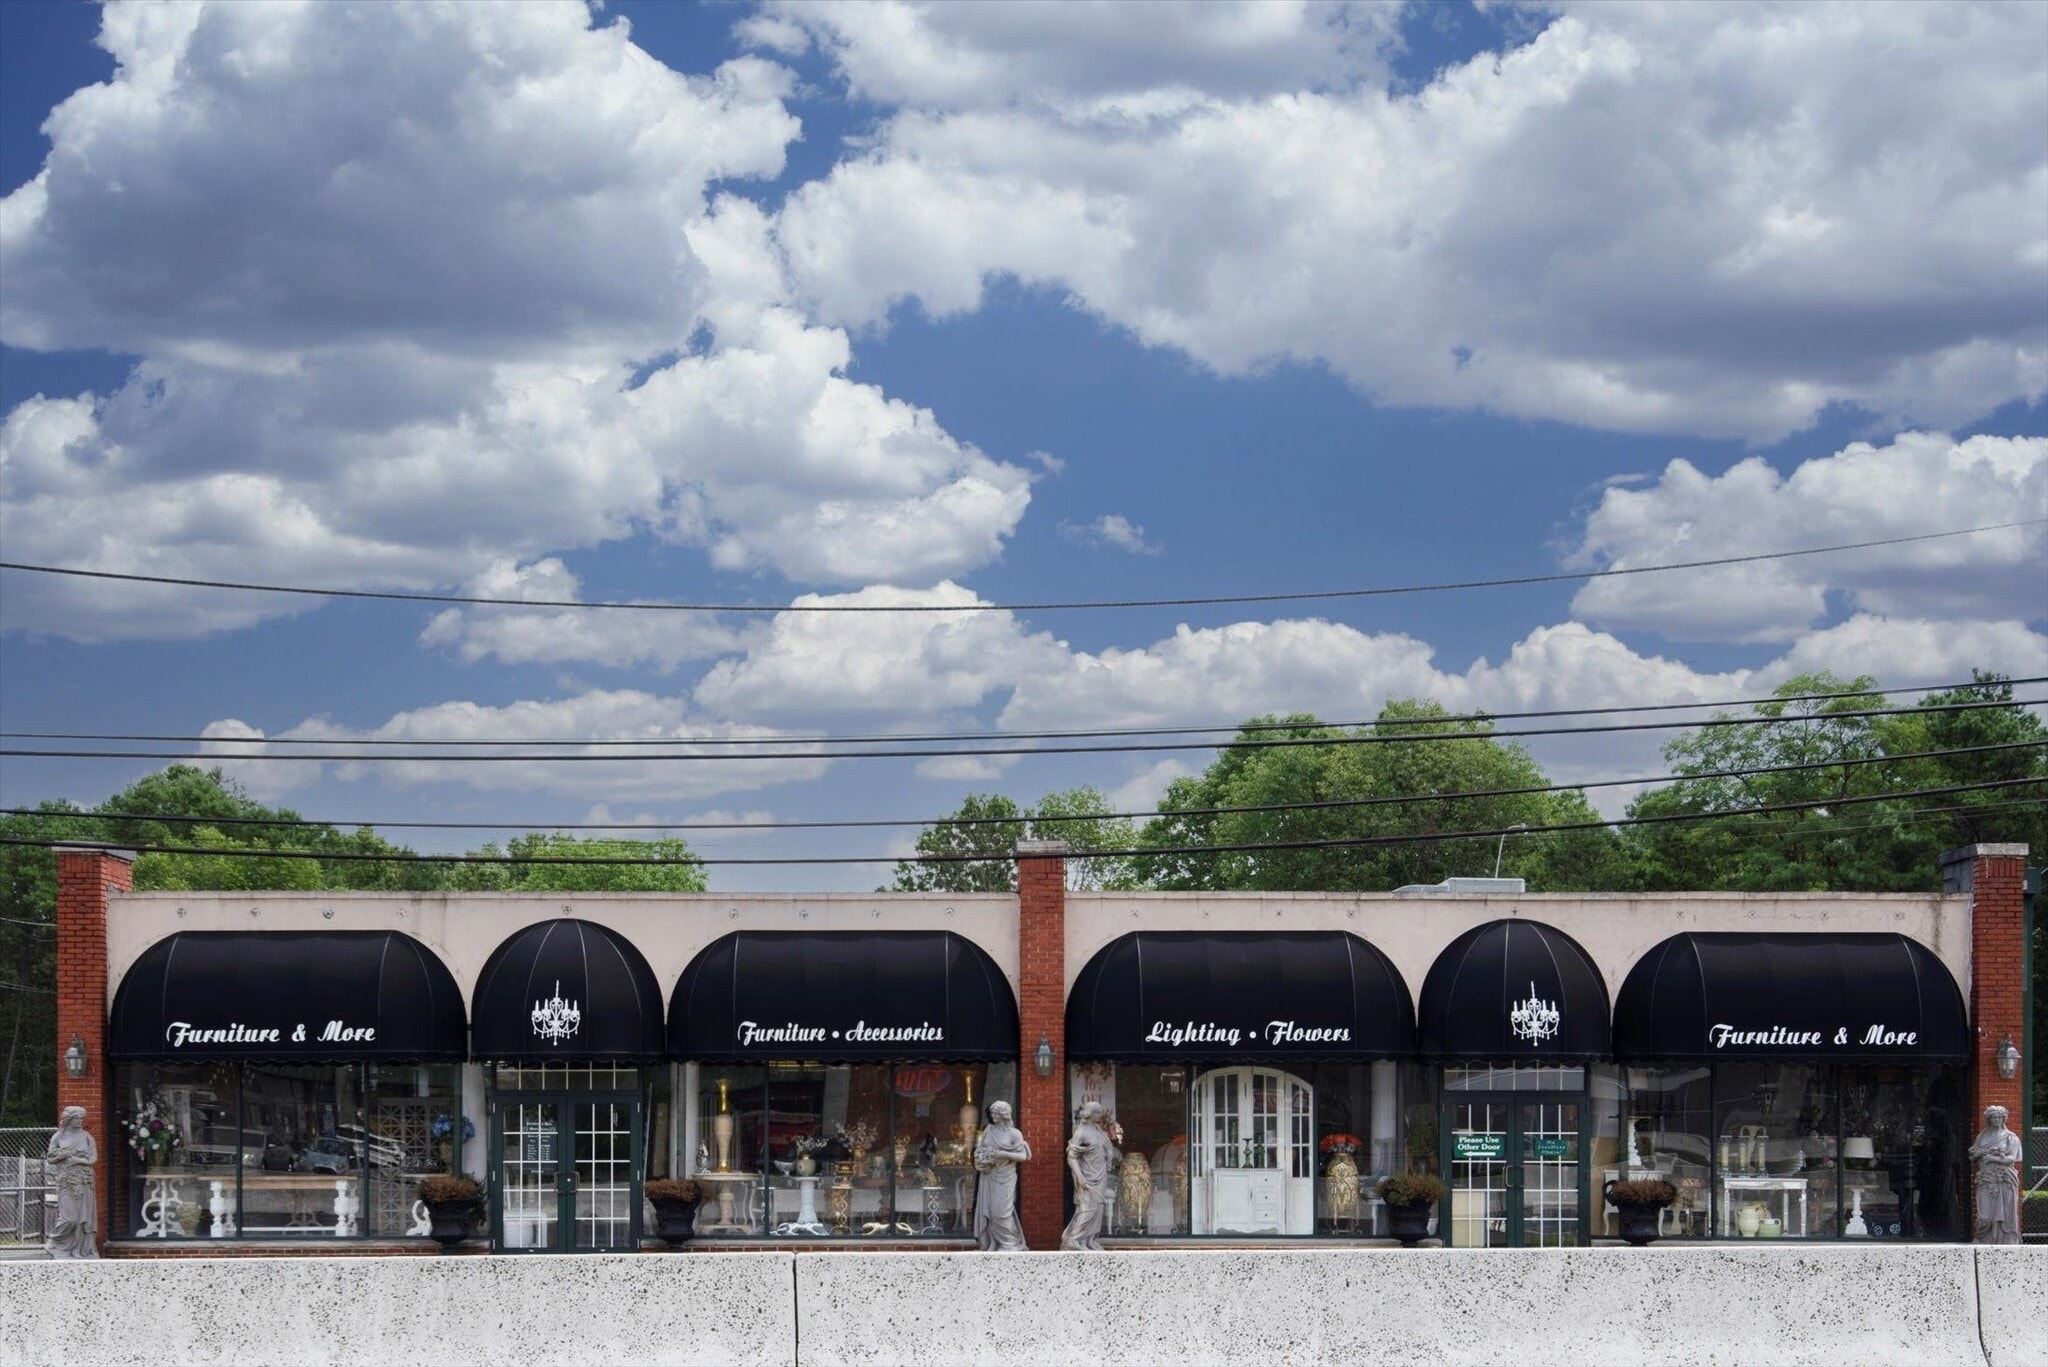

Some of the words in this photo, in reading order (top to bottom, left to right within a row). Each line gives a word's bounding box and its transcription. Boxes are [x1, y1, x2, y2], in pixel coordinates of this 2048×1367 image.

[166, 1021, 281, 1048] Furniture
[291, 1023, 306, 1042] &
[317, 1020, 377, 1042] More
[737, 1020, 827, 1046] Furniture
[845, 1020, 945, 1042] Accessories
[1145, 1021, 1242, 1046] Lighting
[1264, 1020, 1352, 1045] Flowers
[1708, 1023, 1822, 1049] Furniture
[1833, 1026, 1848, 1044] &
[1859, 1024, 1919, 1045] More
[1457, 1143, 1480, 1151] Other
[1481, 1143, 1501, 1151] Door
[1459, 1136, 1483, 1144] Please
[1485, 1136, 1500, 1144] Use
